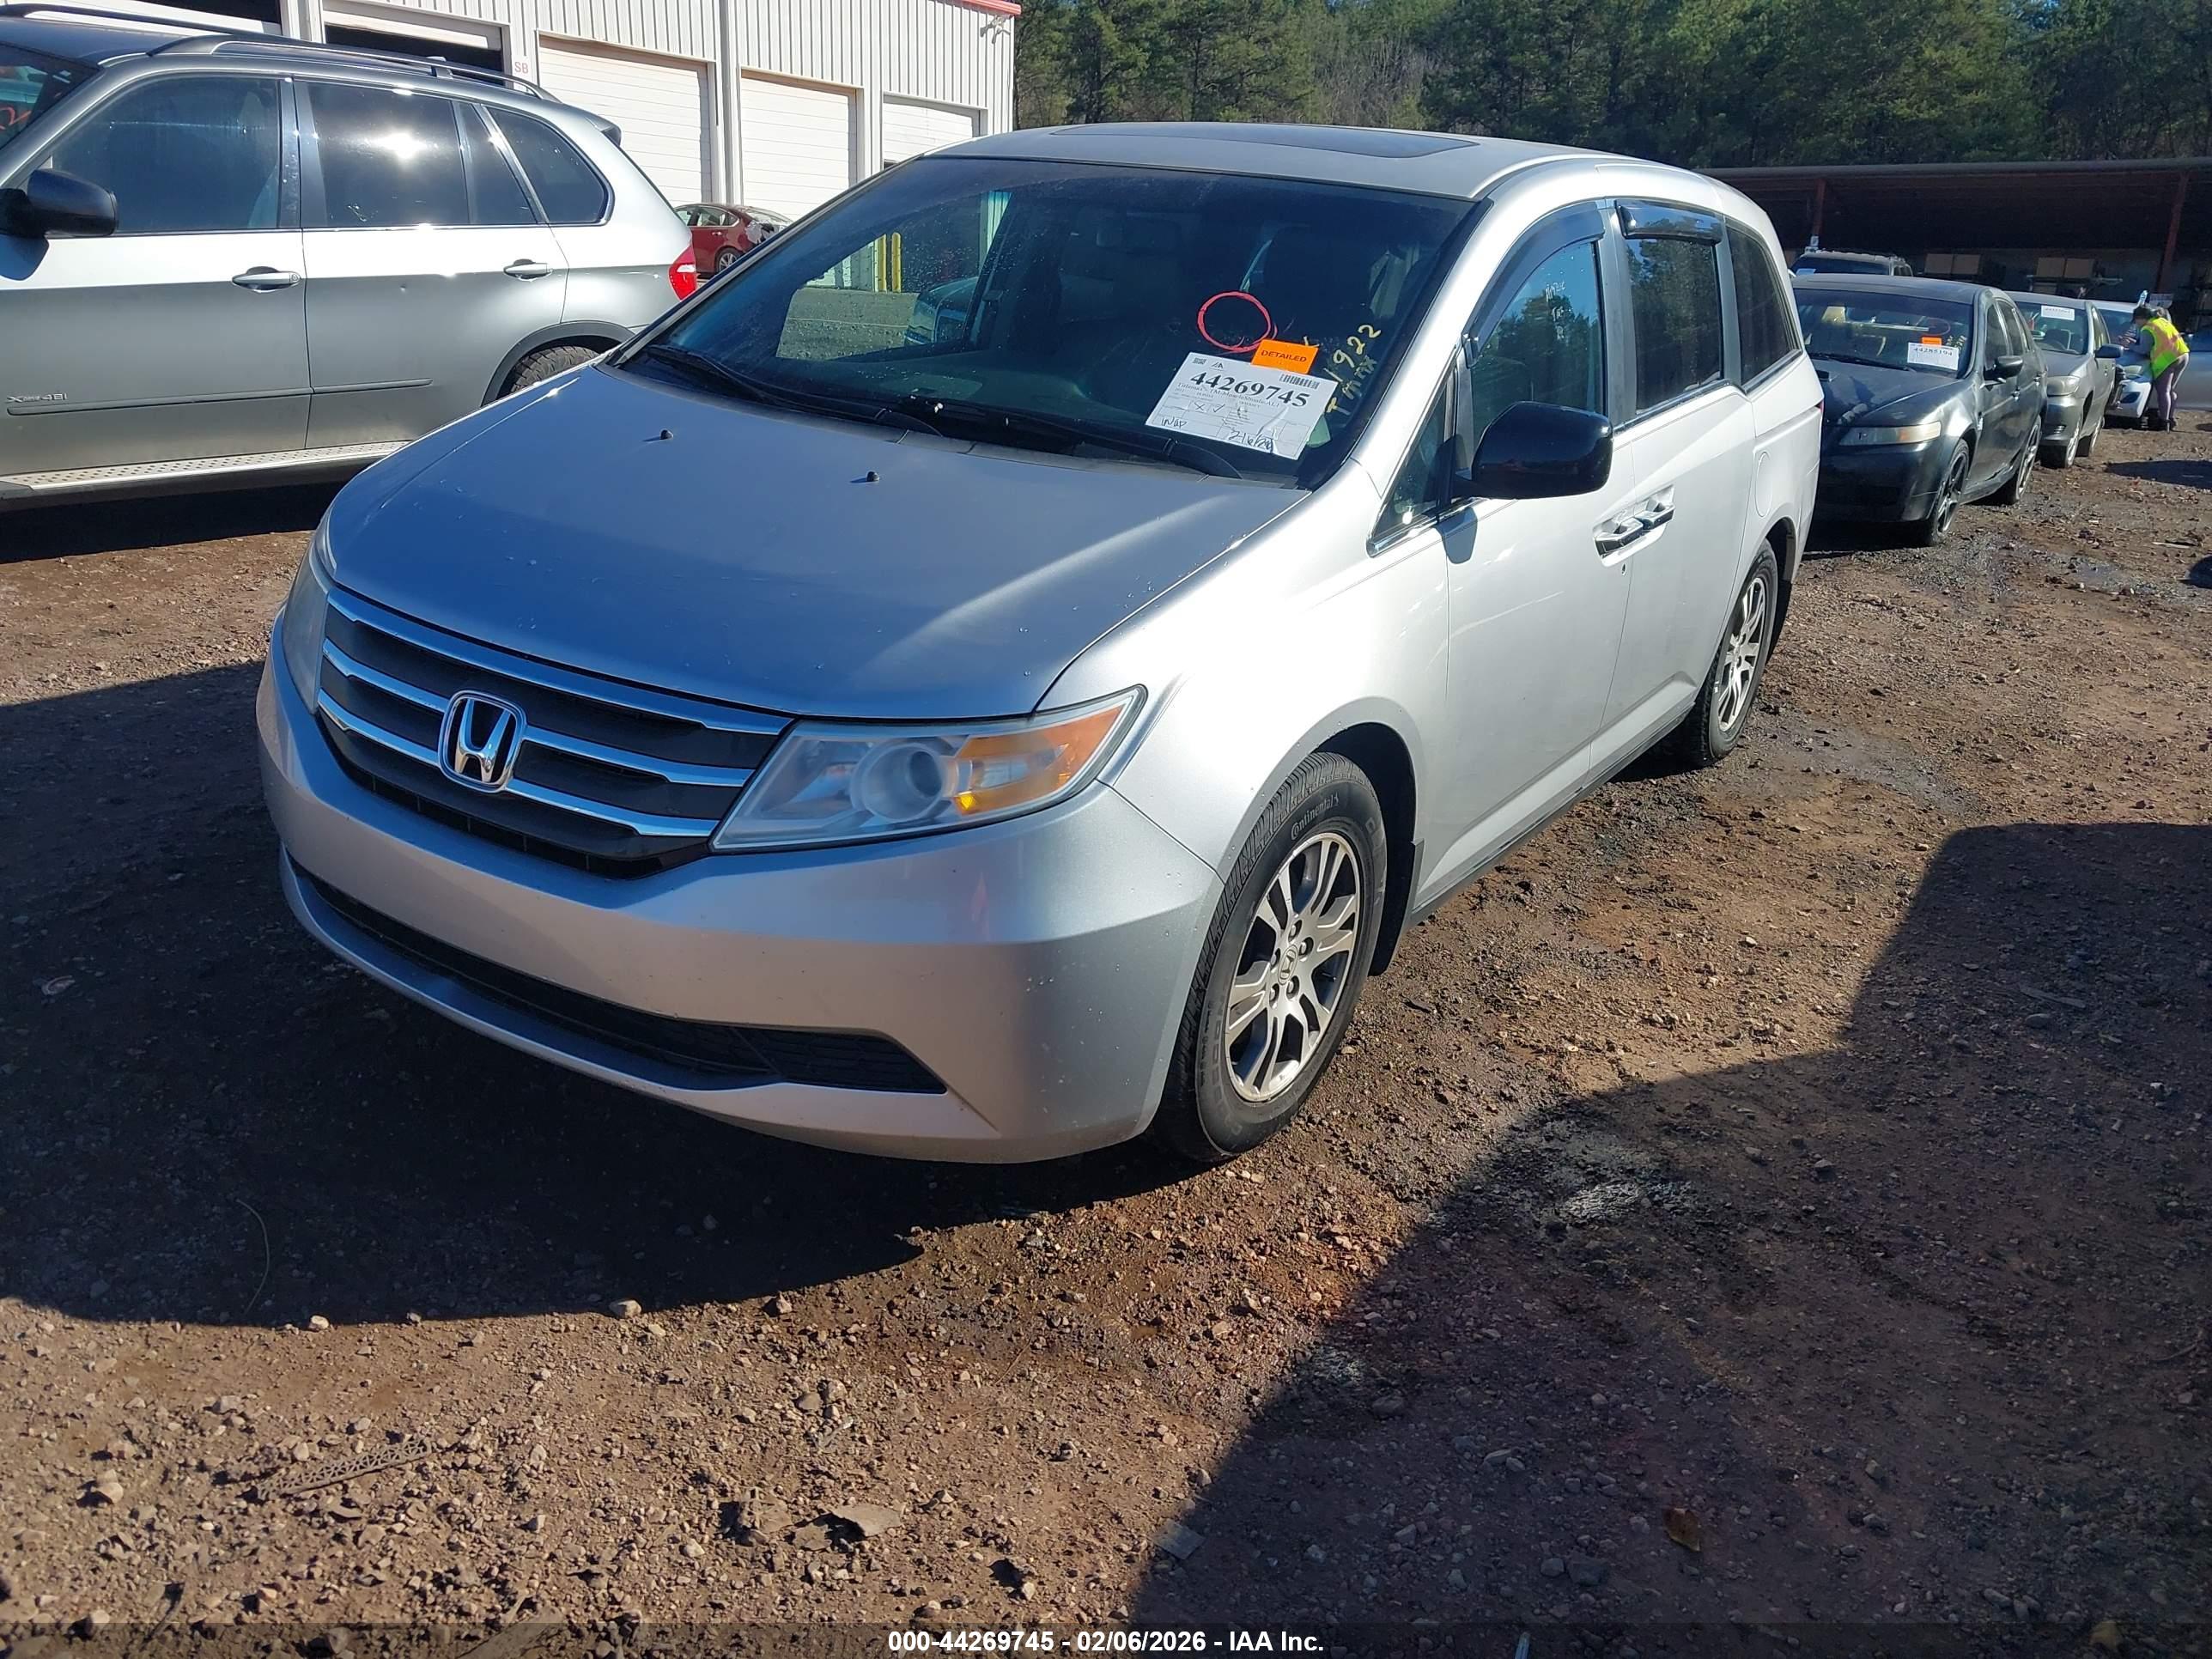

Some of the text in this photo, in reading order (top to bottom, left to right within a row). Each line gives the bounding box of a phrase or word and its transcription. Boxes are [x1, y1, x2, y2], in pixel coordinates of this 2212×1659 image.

[1261, 349, 1307, 362] DETAILED
[1190, 372, 1310, 408] 44269745
[1291, 794, 1334, 841] Continental
